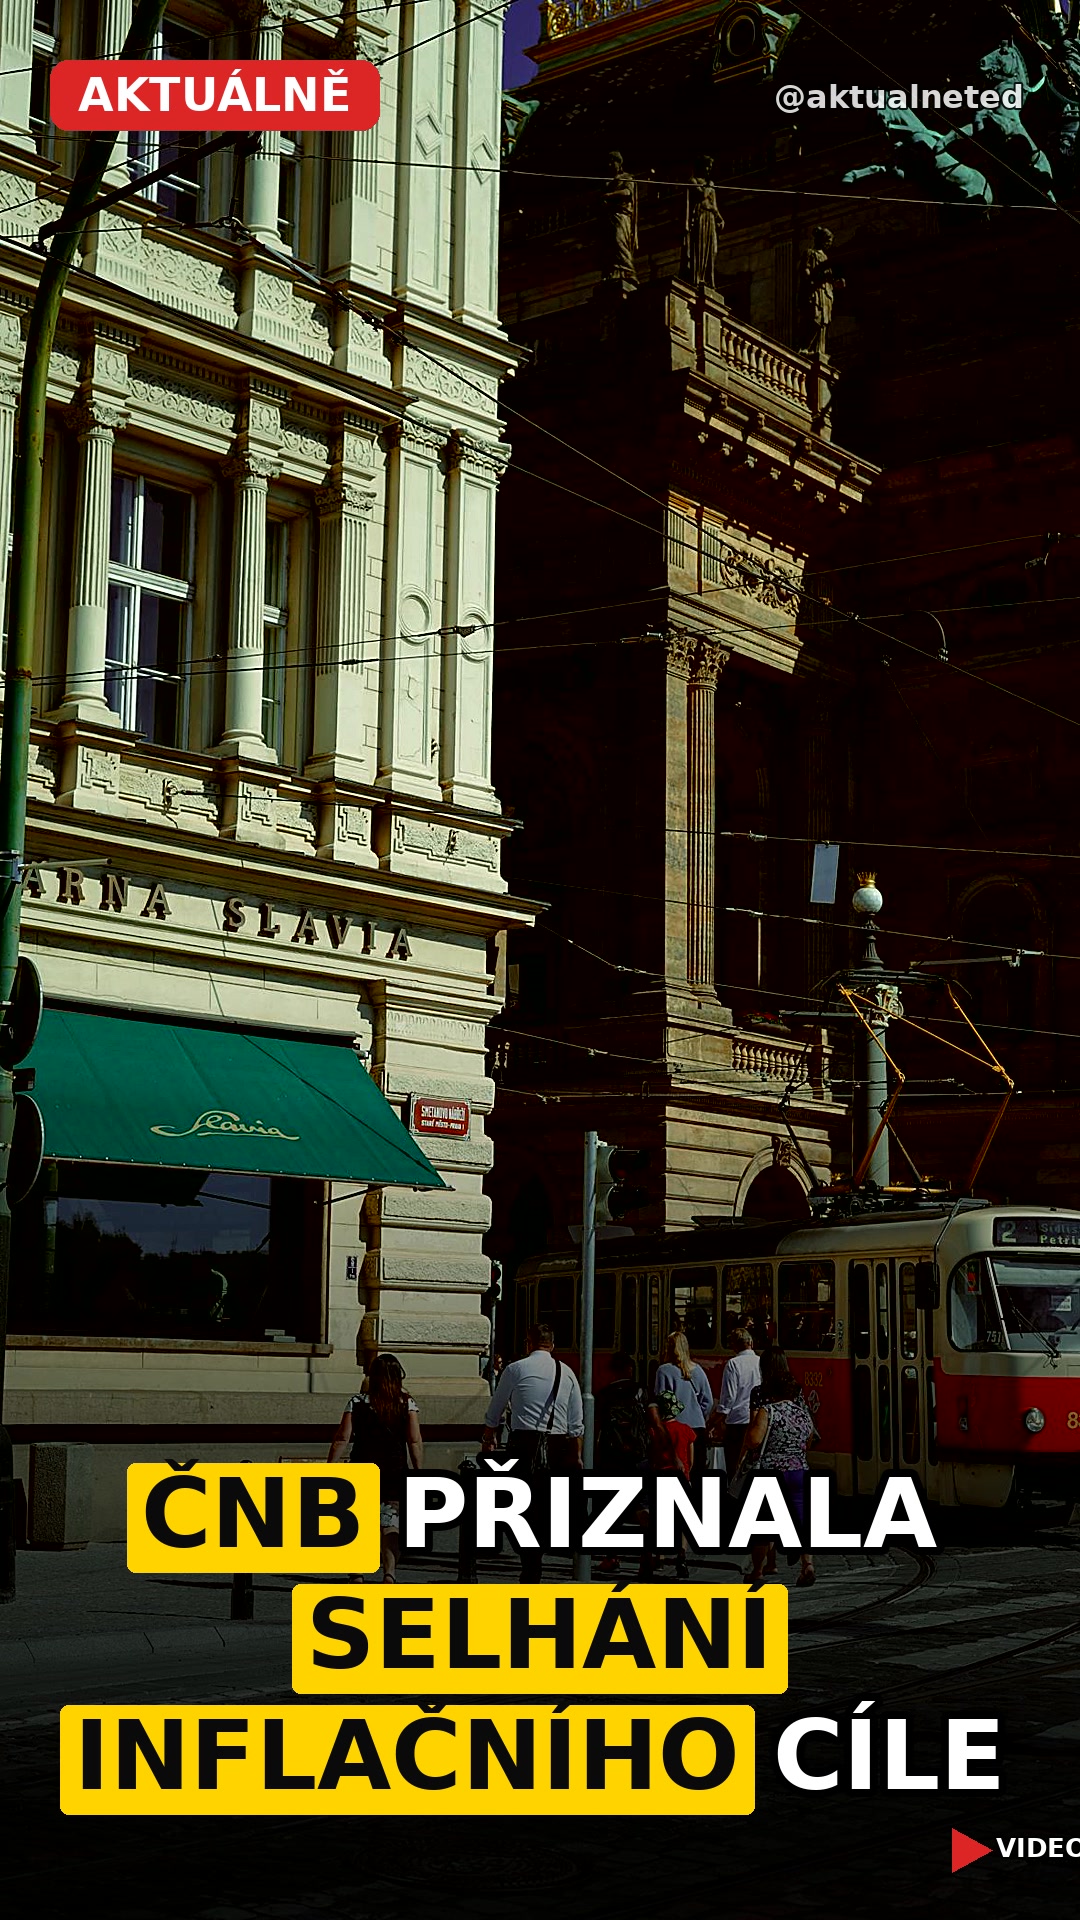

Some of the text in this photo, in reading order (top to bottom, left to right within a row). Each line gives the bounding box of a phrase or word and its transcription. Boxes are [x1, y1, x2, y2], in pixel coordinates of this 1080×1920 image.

[223, 897, 413, 960] SLAVIA
[150, 1110, 300, 1140] Slavia
[1001, 1220, 1017, 1243] 2
